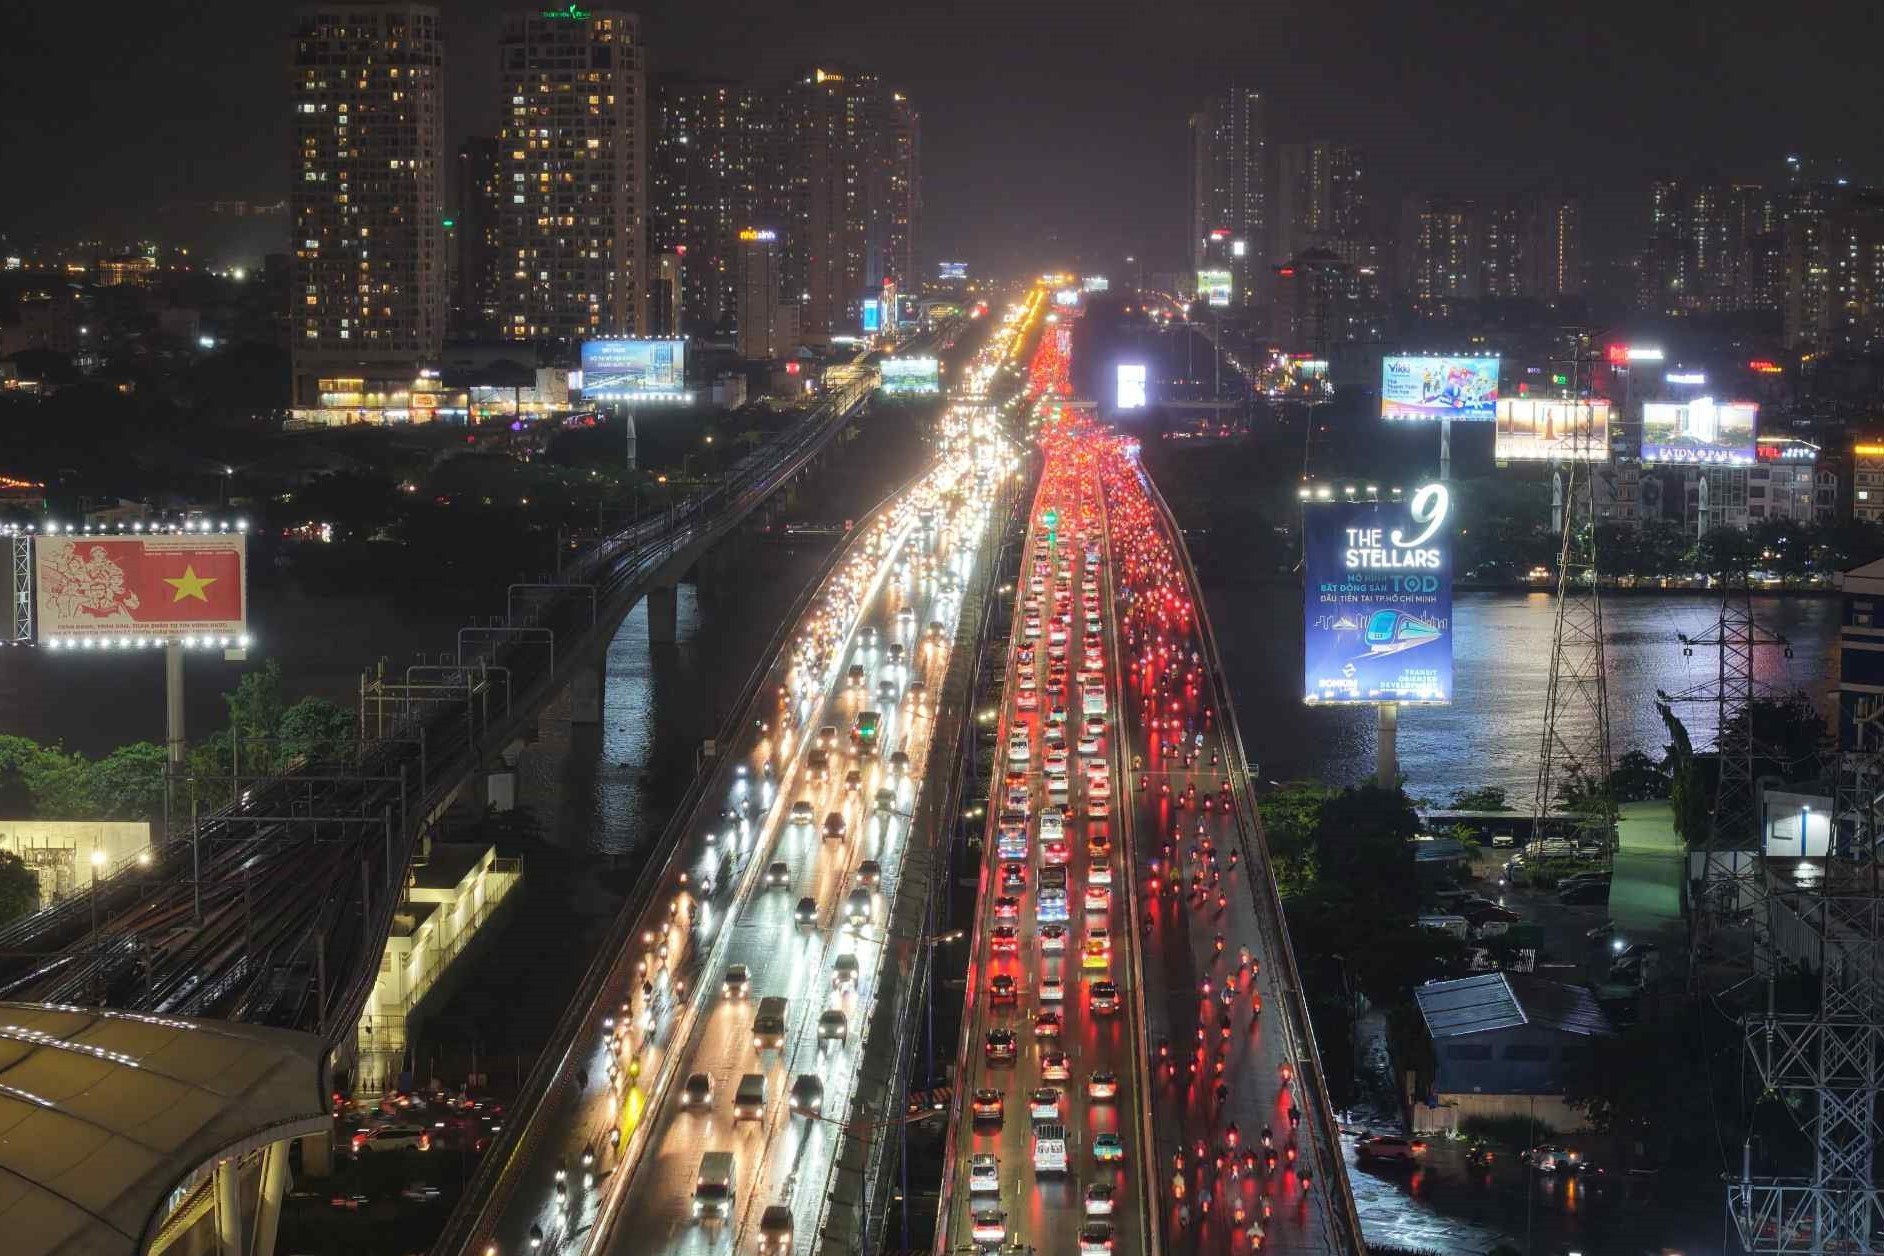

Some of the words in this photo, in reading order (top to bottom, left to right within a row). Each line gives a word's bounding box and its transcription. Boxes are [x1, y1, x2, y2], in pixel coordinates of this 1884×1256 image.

[1660, 447, 1695, 458] EATON
[1707, 449, 1735, 459] PARK
[1391, 483, 1449, 548] 9
[1346, 528, 1382, 548] THE
[1345, 549, 1441, 568] STELLARS
[1390, 574, 1440, 593] TOD
